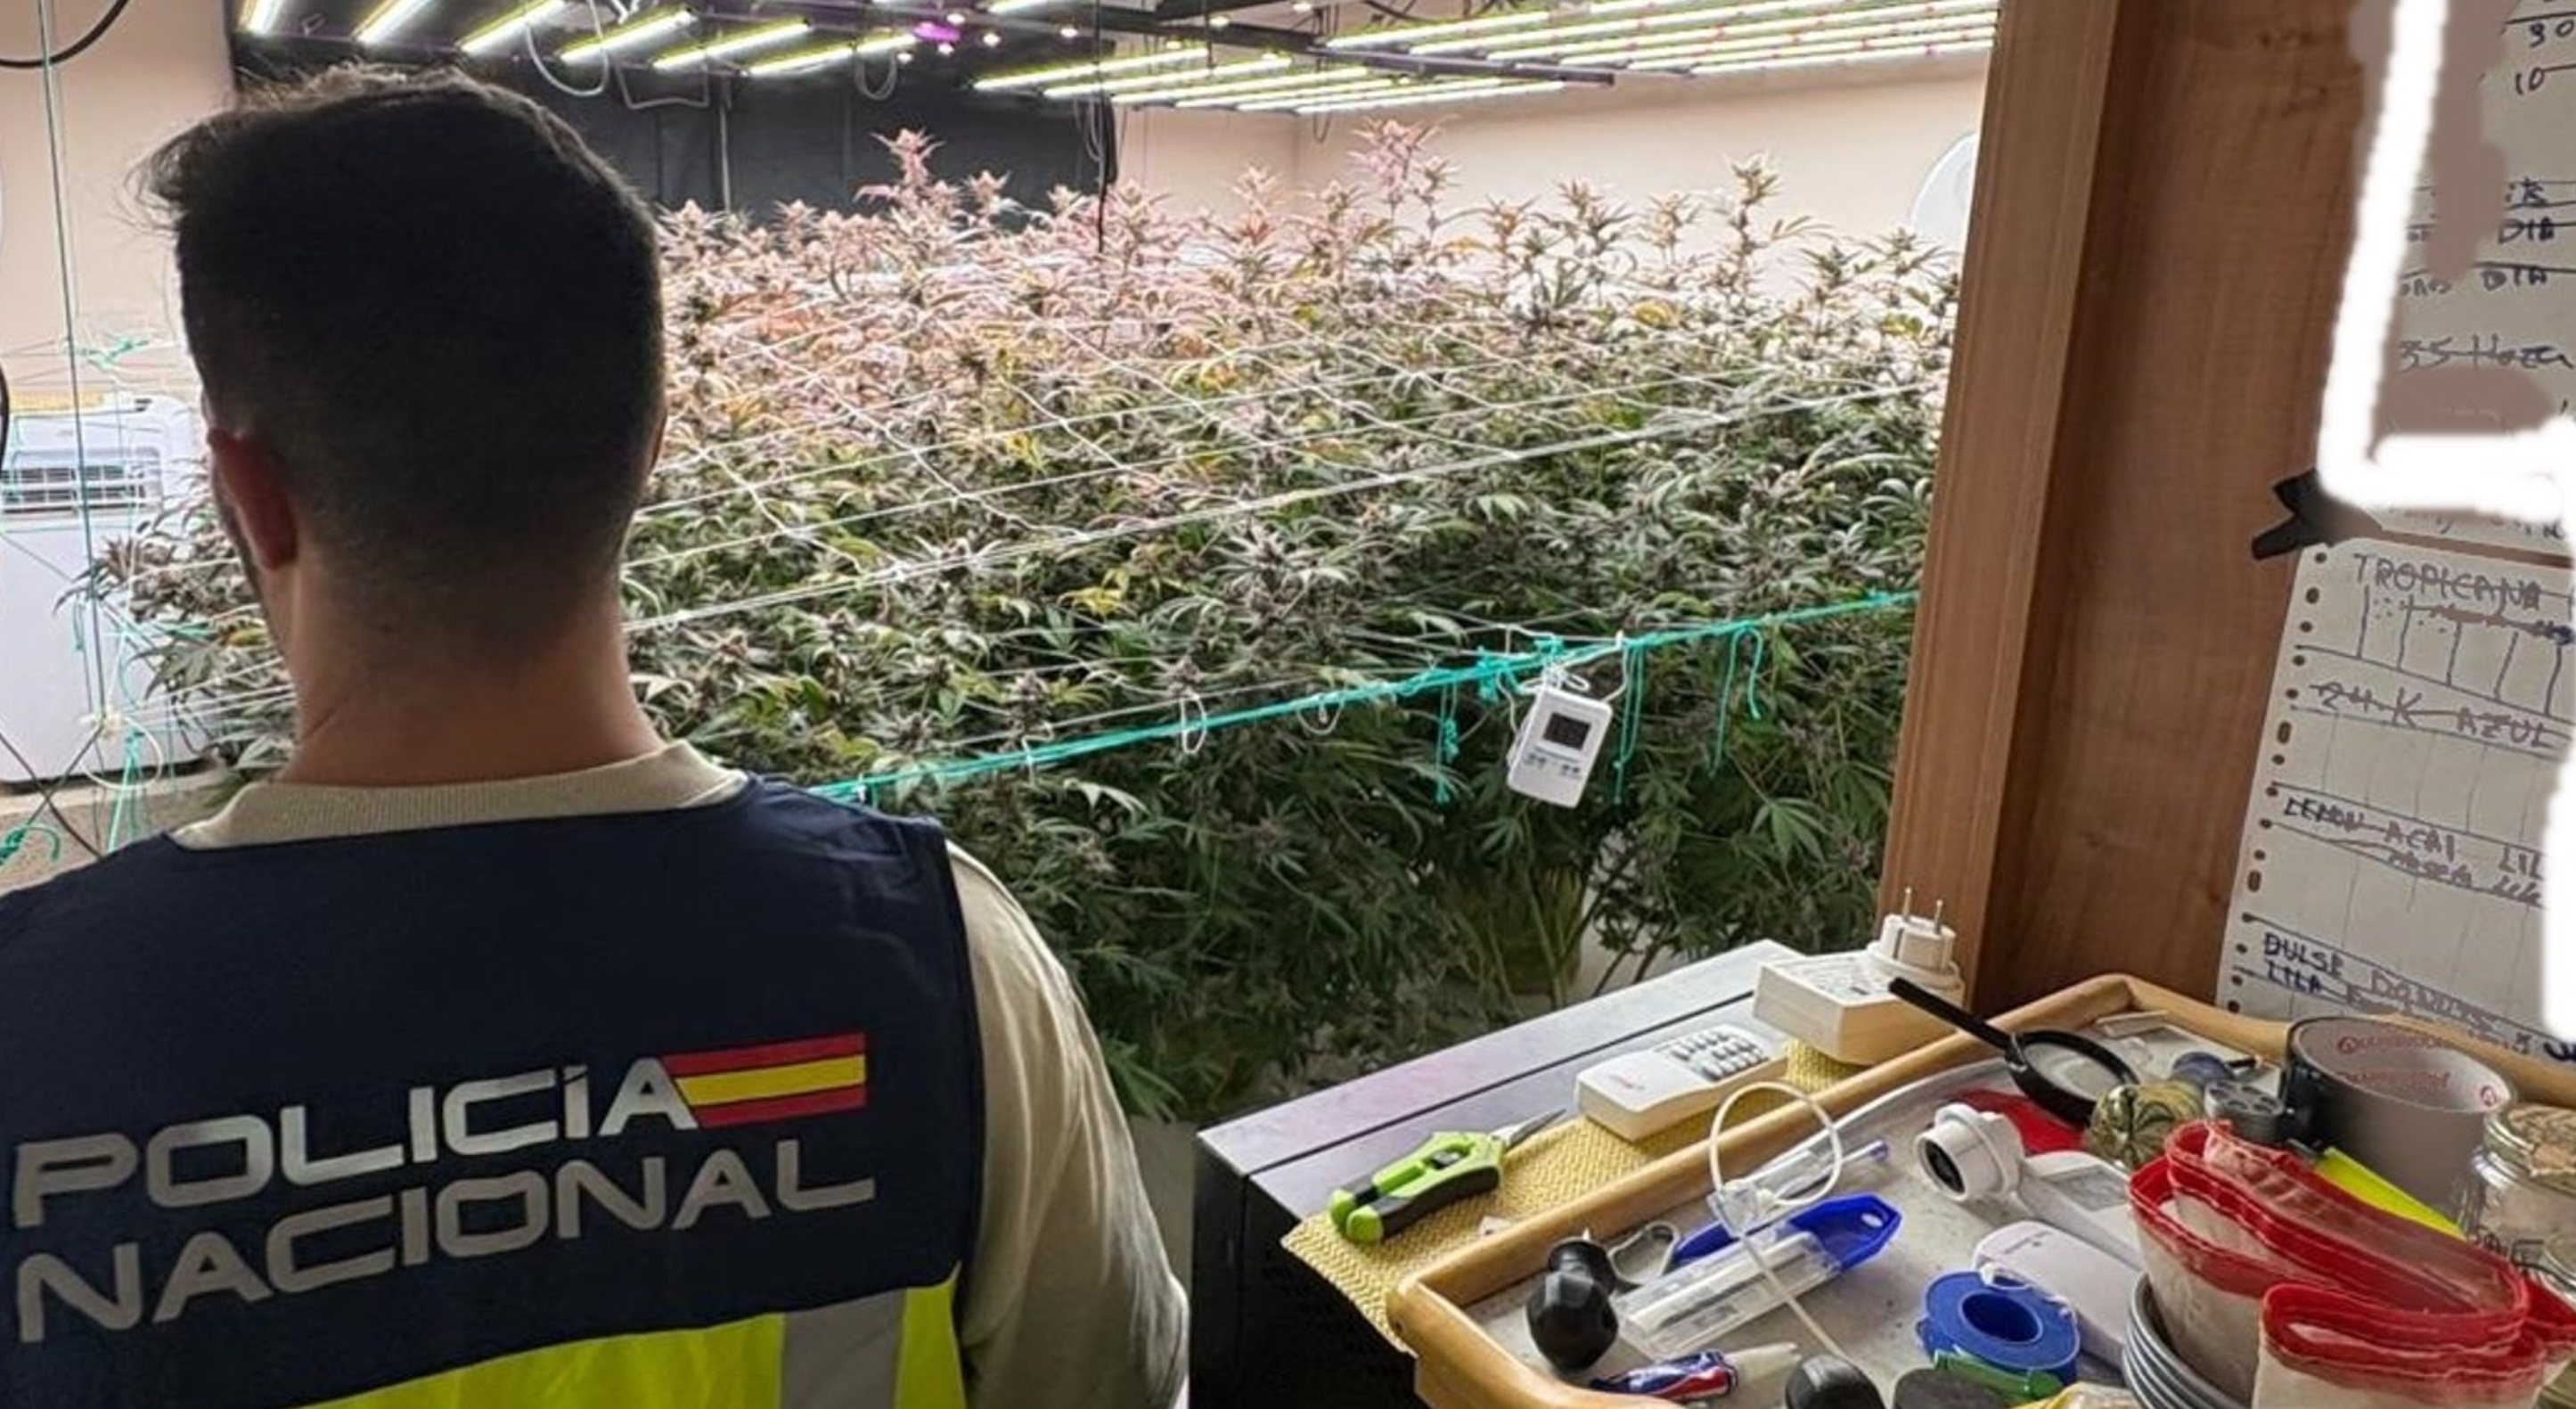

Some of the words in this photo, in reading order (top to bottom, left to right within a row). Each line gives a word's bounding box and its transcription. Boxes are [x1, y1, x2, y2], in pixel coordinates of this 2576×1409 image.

[2515, 67, 2545, 95] 10
[2392, 686, 2424, 729] K
[2456, 707, 2556, 750] AZUL
[16, 1138, 876, 1344] NACIONAL
